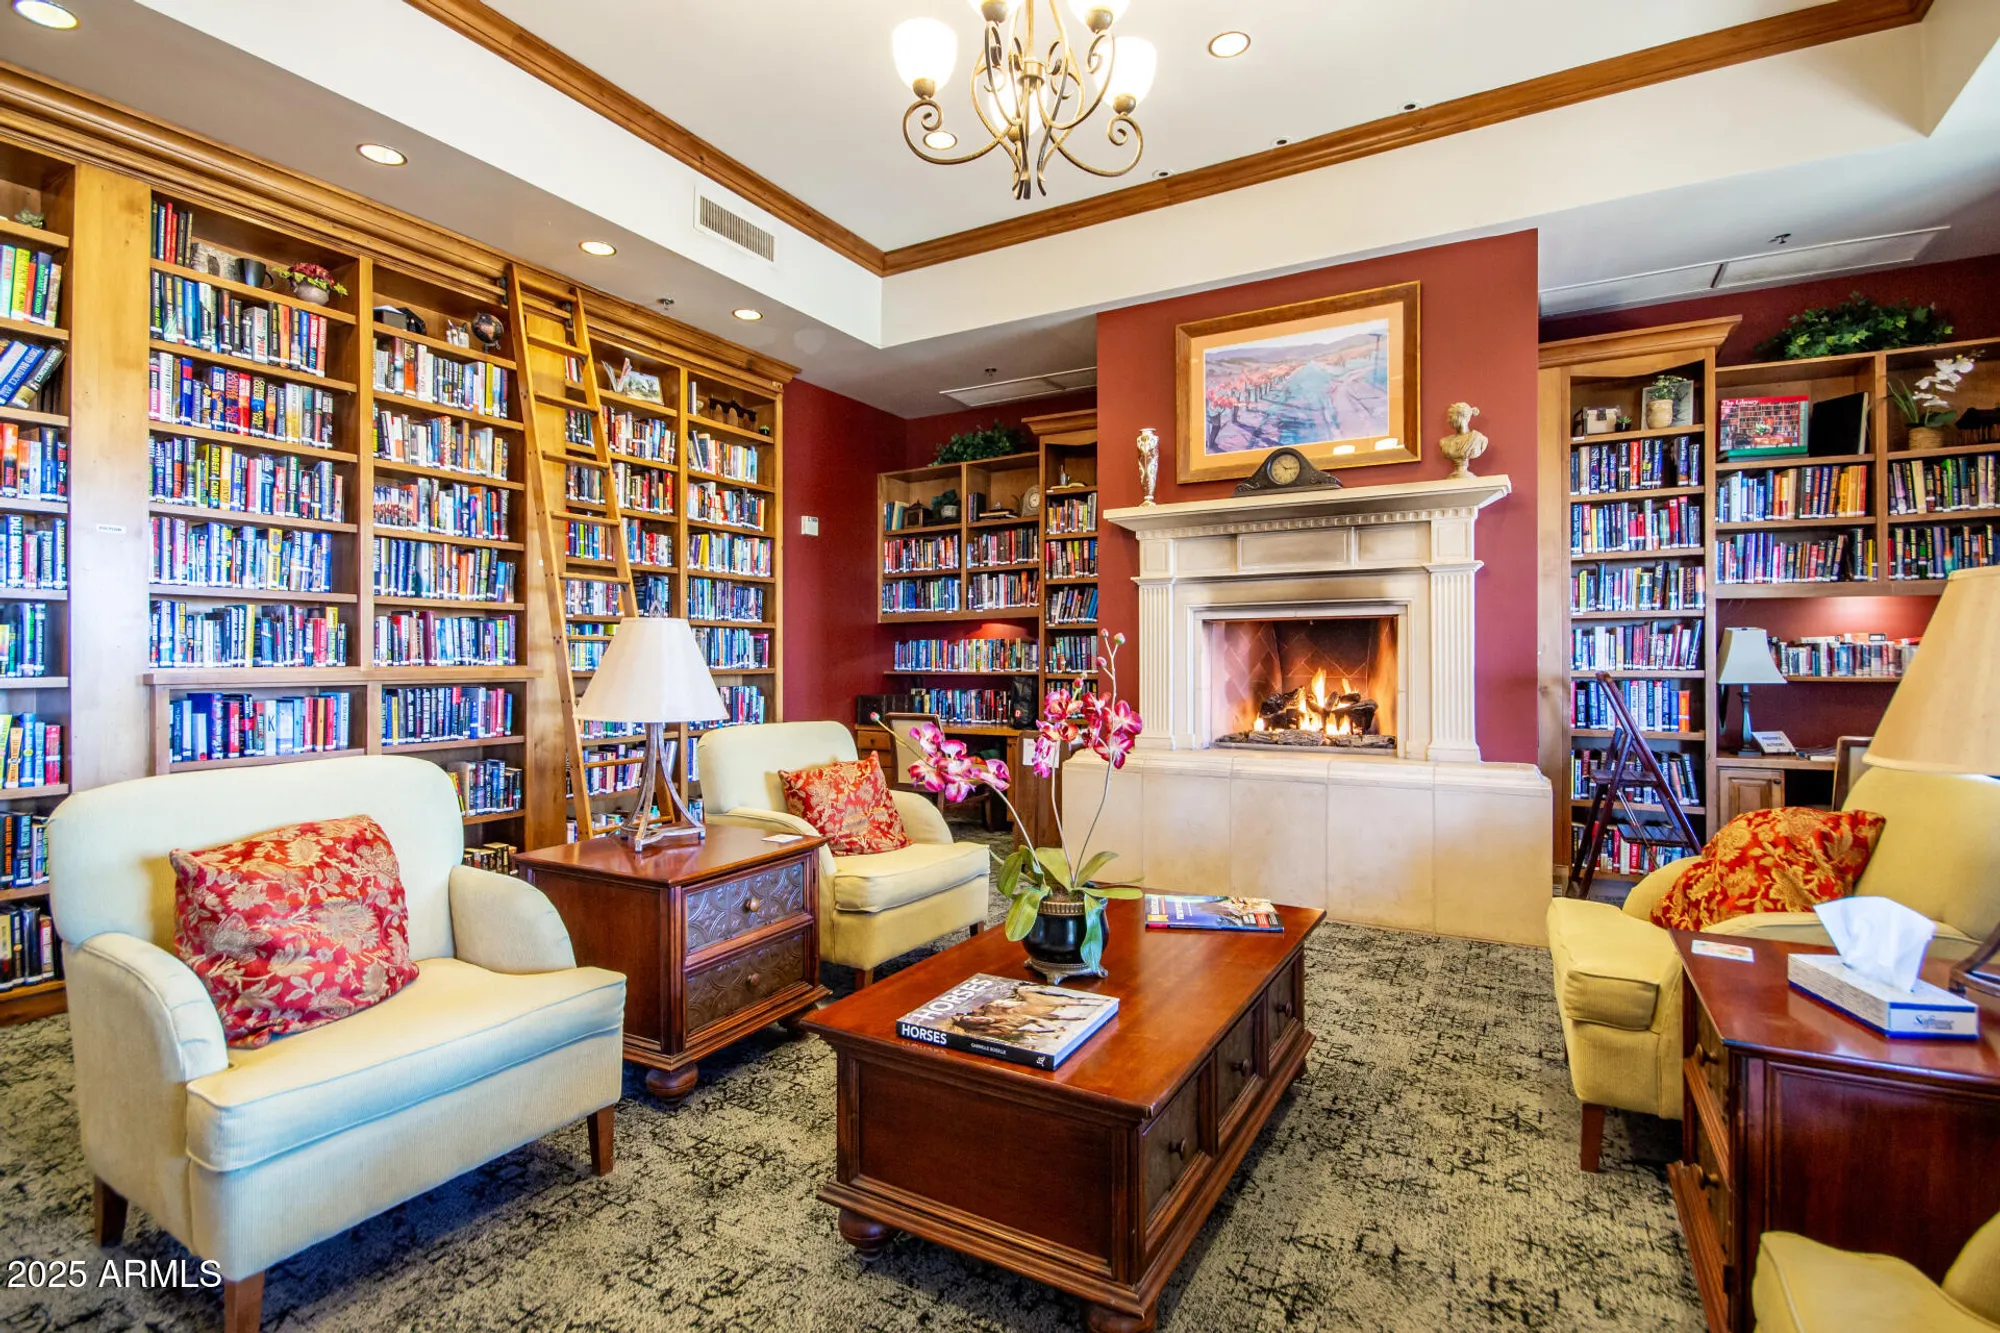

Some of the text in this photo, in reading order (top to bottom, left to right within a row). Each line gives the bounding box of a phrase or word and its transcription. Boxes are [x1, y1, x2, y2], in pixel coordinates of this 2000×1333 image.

[1735, 398, 1758, 406] Library
[212, 447, 220, 475] ROBERT
[911, 978, 993, 1021] HORSES
[901, 1024, 948, 1045] HORSES
